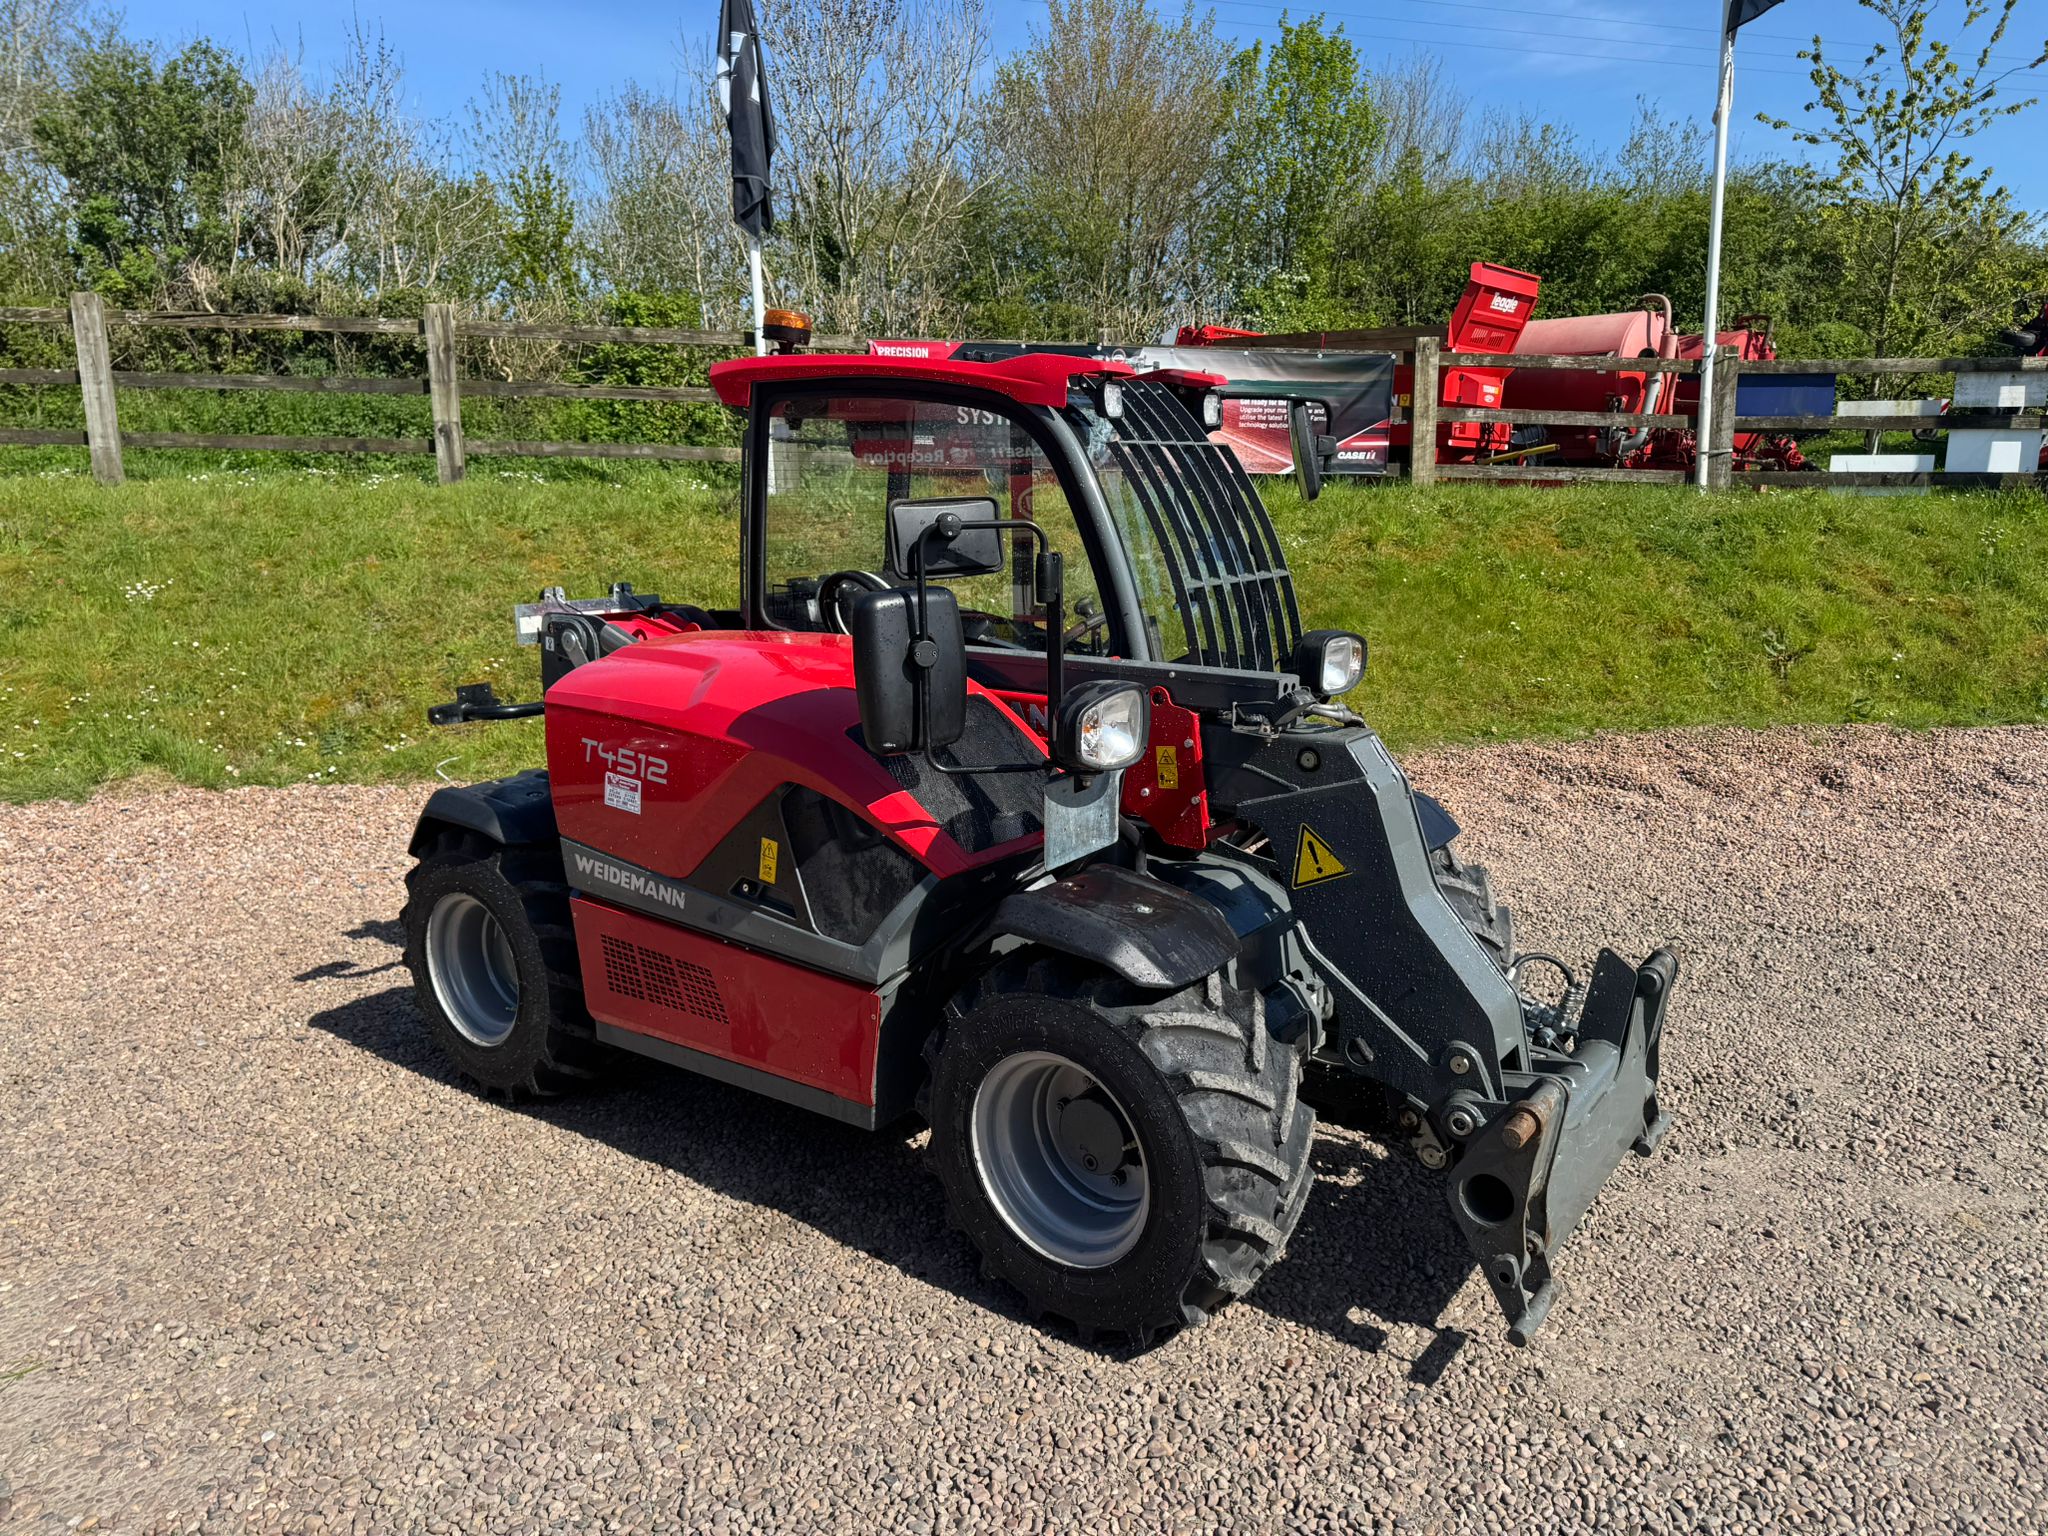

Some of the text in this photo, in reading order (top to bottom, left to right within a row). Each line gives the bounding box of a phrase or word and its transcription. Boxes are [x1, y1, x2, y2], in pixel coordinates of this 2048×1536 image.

[1491, 292, 1518, 310] Teagle
[878, 347, 928, 359] PRECISION
[1240, 406, 1263, 414] Upgrade
[1239, 421, 1267, 429] technology
[581, 737, 669, 784] T4512
[575, 853, 685, 909] WEIDEMANN
